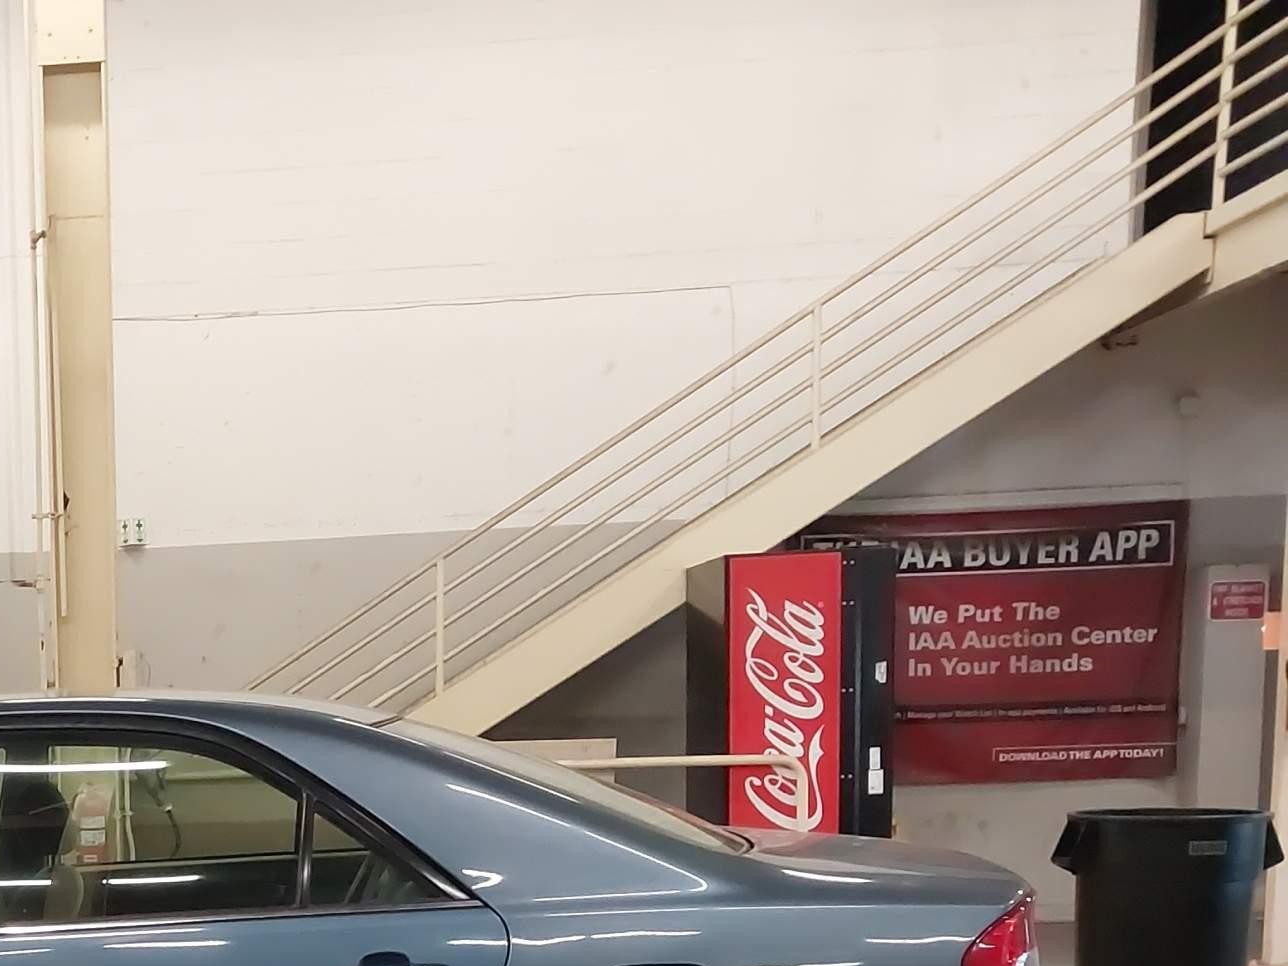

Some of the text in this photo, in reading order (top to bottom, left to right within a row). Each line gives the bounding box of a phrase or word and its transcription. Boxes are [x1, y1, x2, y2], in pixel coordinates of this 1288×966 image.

[963, 532, 1080, 568] BUYER
[1088, 528, 1161, 563] APP
[908, 602, 1061, 625] We Put The
[908, 625, 1158, 651] IAA Auction Center
[908, 658, 932, 677] In
[940, 657, 1001, 677] Your
[1009, 653, 1094, 675] Hands
[998, 747, 1164, 762] DOWNLOAD THE APP TODAY!
